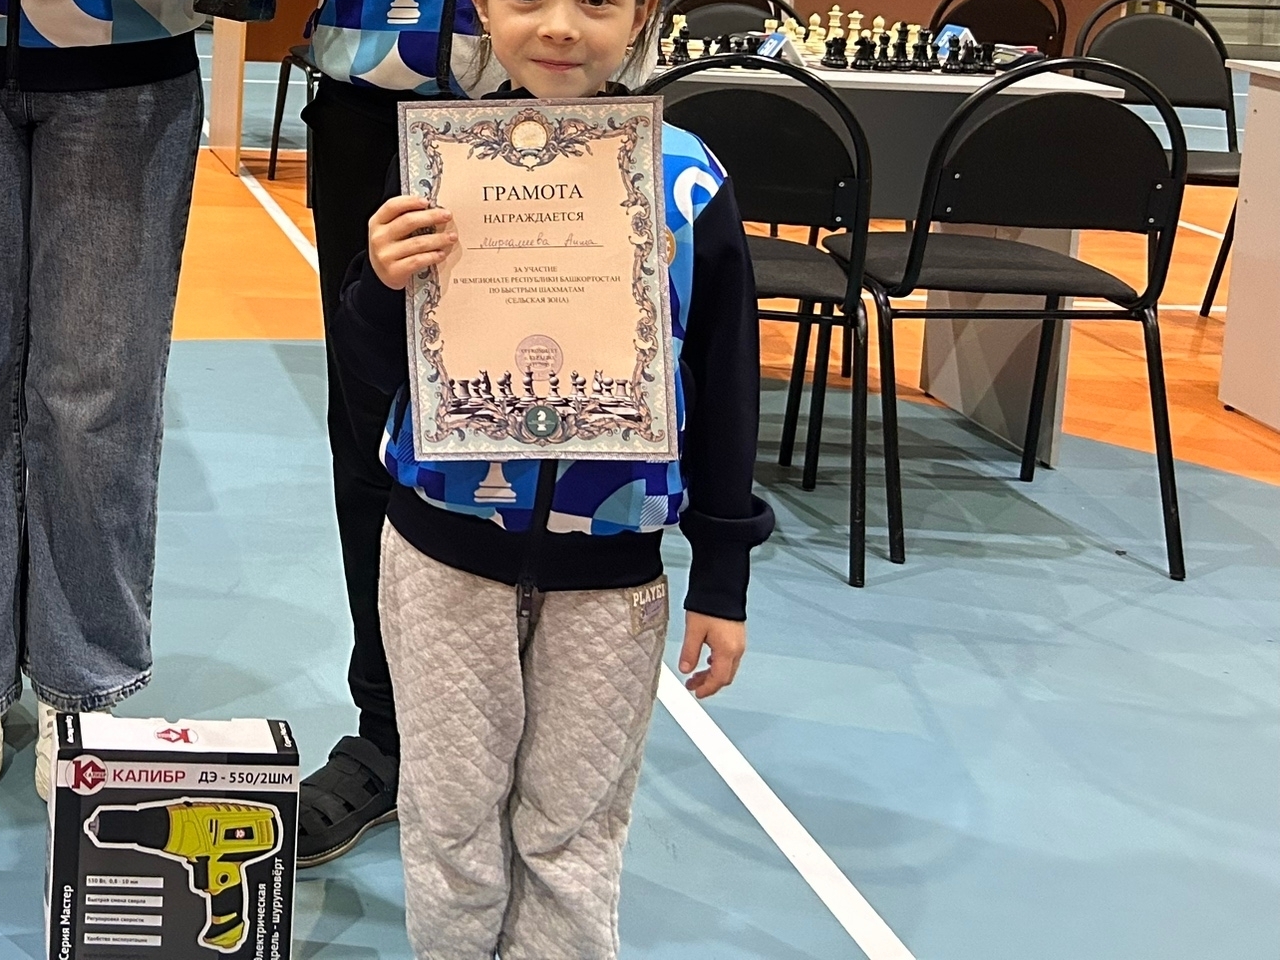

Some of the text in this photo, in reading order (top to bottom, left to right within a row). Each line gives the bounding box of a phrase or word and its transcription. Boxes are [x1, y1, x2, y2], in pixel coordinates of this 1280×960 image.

[483, 184, 584, 201] ГРАМОТА
[483, 211, 584, 224] НАГРАЖДАЕТСЯ
[511, 276, 558, 284] РЕСПУБЛИКИ
[505, 296, 569, 305] (СЕЛЬСКАЯ ЗОНА)
[113, 769, 186, 783] КАЛИБР
[198, 771, 218, 784] ДЭ
[229, 771, 293, 786] 550/2ШМ
[272, 857, 285, 924] шуруповёрт
[58, 884, 74, 960] Серия Мастер
